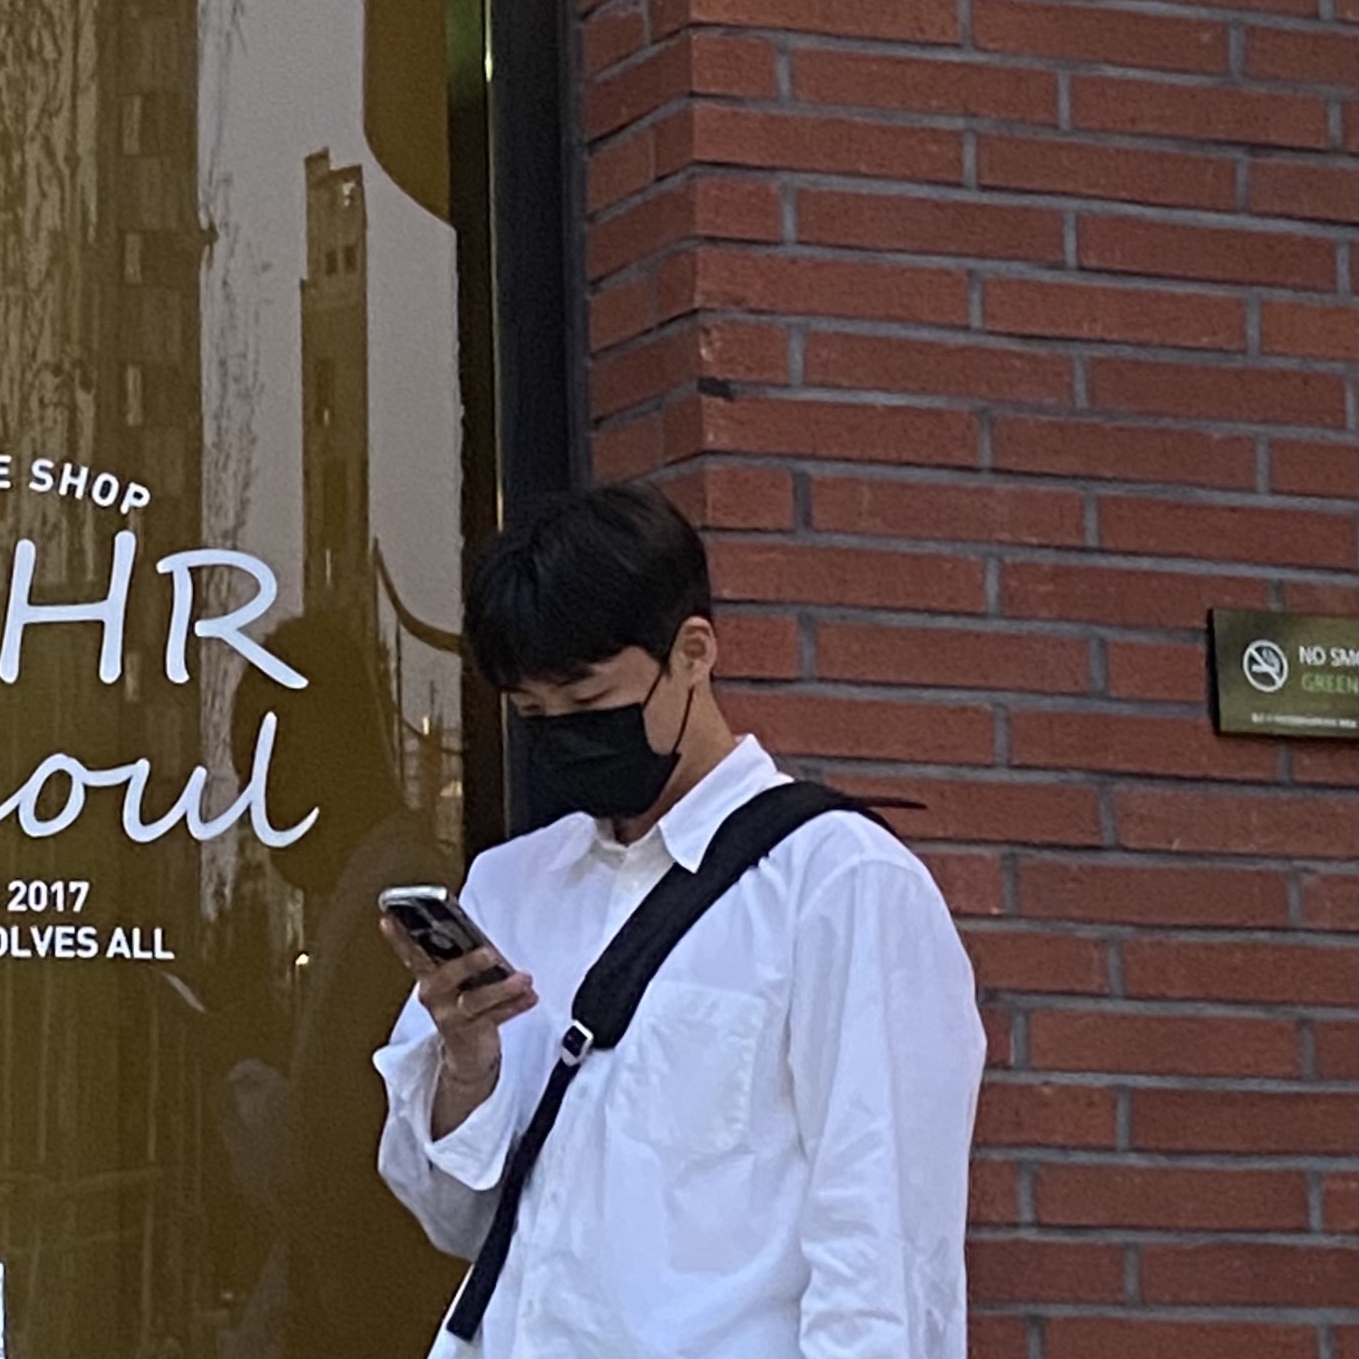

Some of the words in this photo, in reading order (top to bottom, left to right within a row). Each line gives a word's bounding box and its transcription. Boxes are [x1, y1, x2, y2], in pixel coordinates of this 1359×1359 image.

[29, 457, 151, 515] SHOP
[1298, 645, 1327, 666] NO
[7, 880, 91, 913] 2017
[106, 927, 176, 960] ALL
